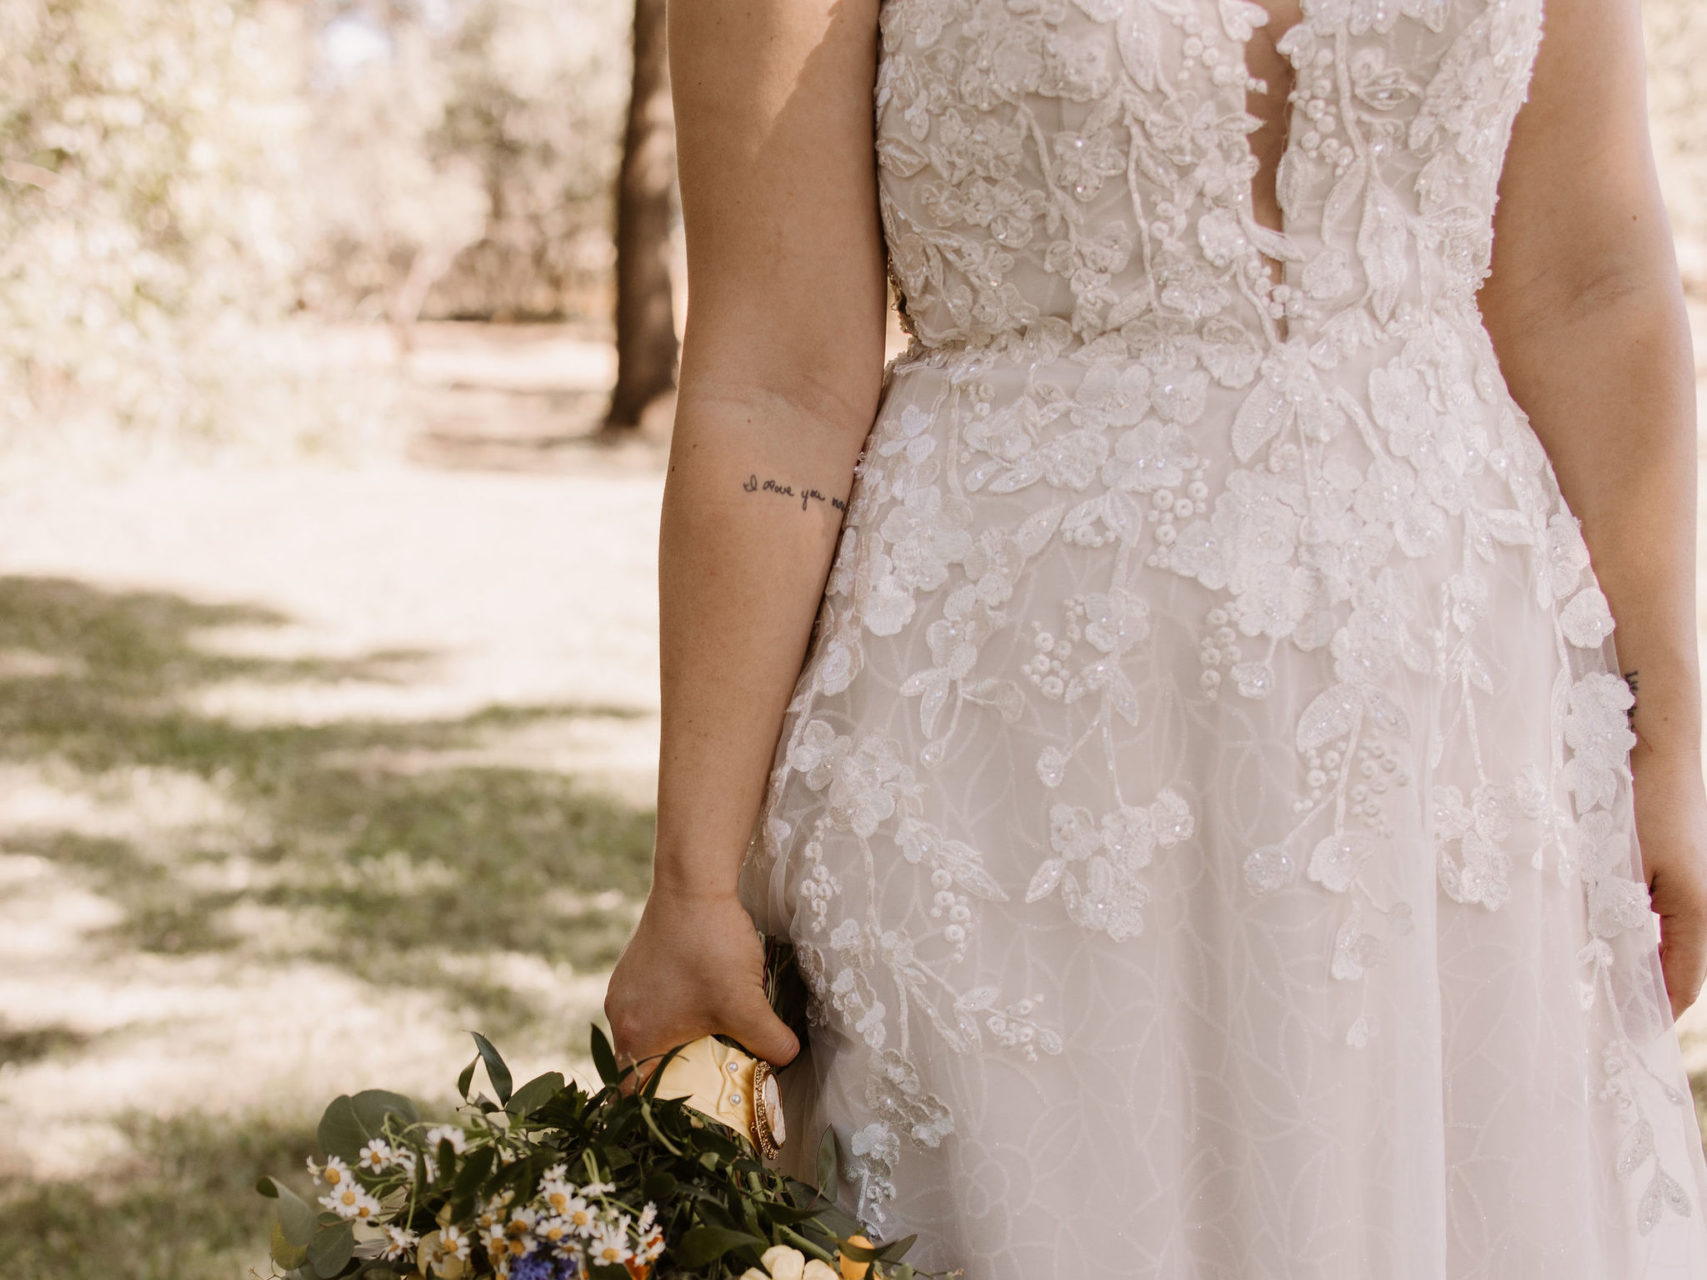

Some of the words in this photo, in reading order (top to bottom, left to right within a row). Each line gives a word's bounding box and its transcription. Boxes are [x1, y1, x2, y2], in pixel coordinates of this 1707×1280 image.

[743, 474, 758, 492] I
[763, 479, 794, 497] love
[801, 489, 825, 511] you
